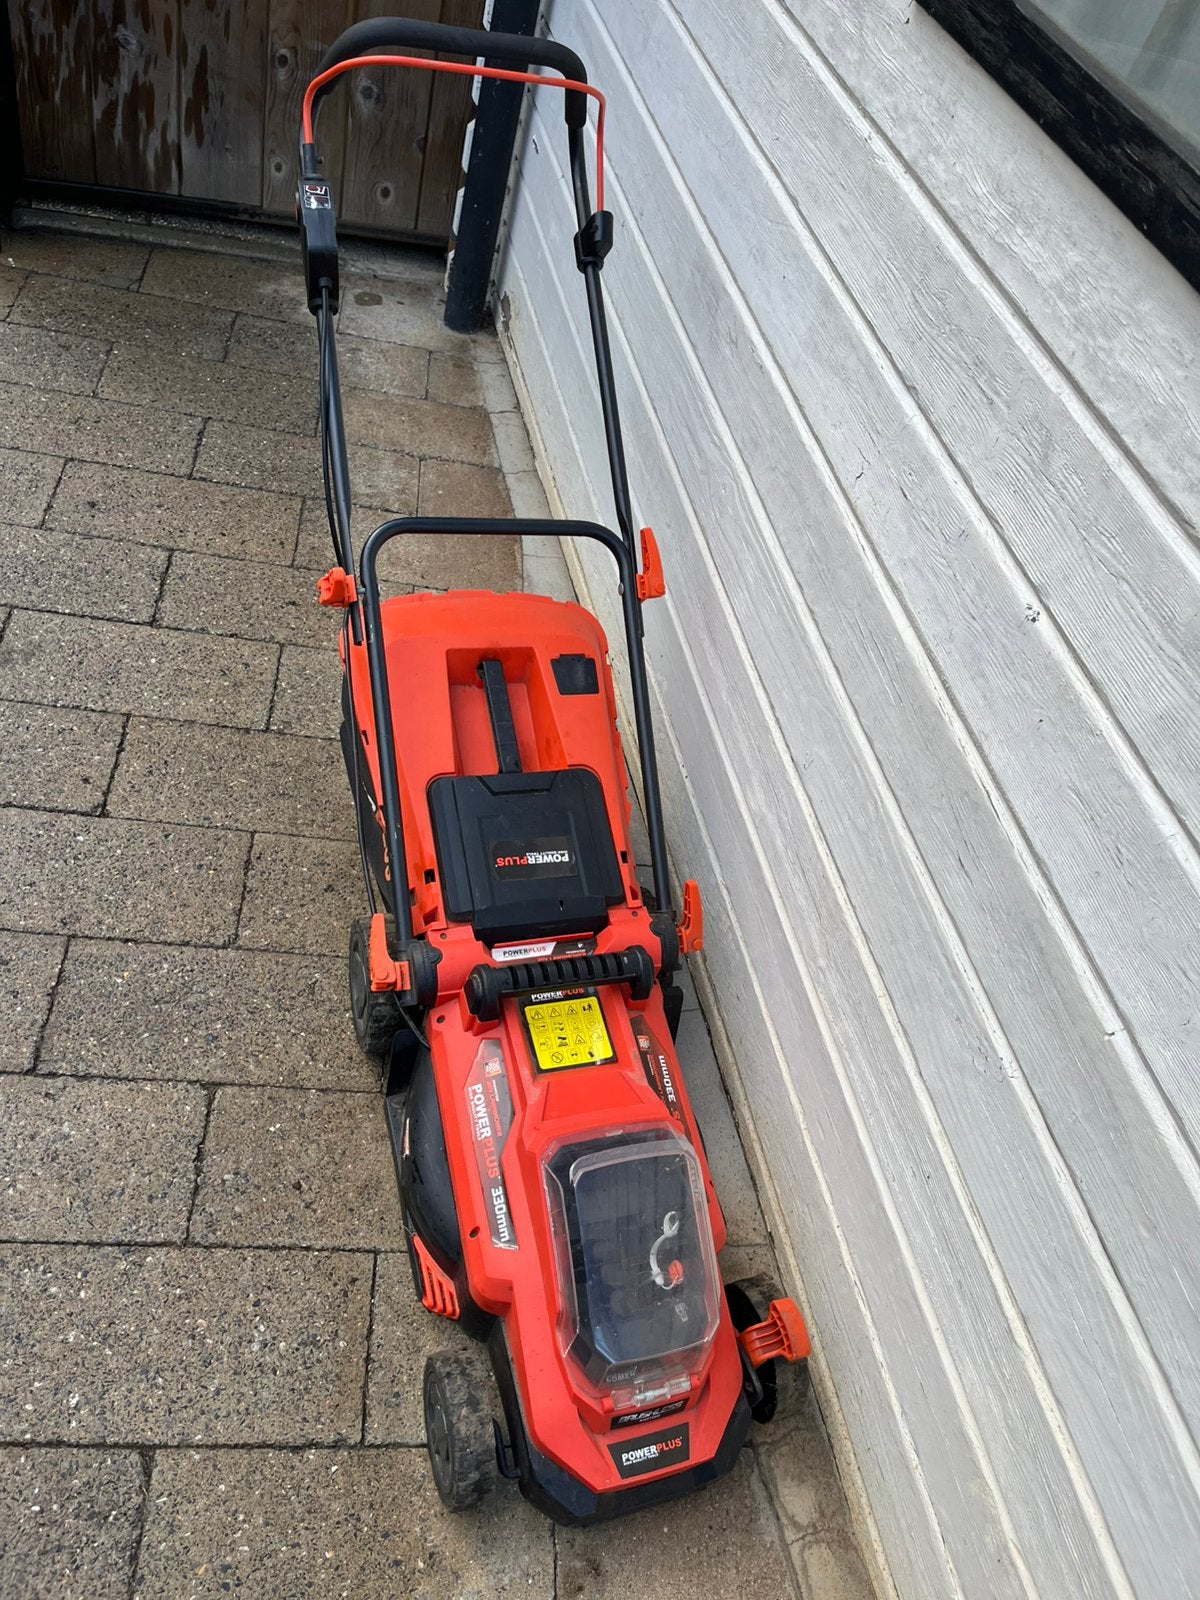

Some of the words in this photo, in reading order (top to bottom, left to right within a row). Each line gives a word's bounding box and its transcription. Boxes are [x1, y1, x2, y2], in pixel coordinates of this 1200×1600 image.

[496, 853, 570, 867] POWERPLUS
[502, 946, 547, 956] POWERPLUS
[658, 1055, 676, 1103] 330mm
[472, 1083, 499, 1179] POWERPLUS
[491, 1185, 510, 1243] 330mm
[622, 1438, 682, 1463] POWERPLUS
